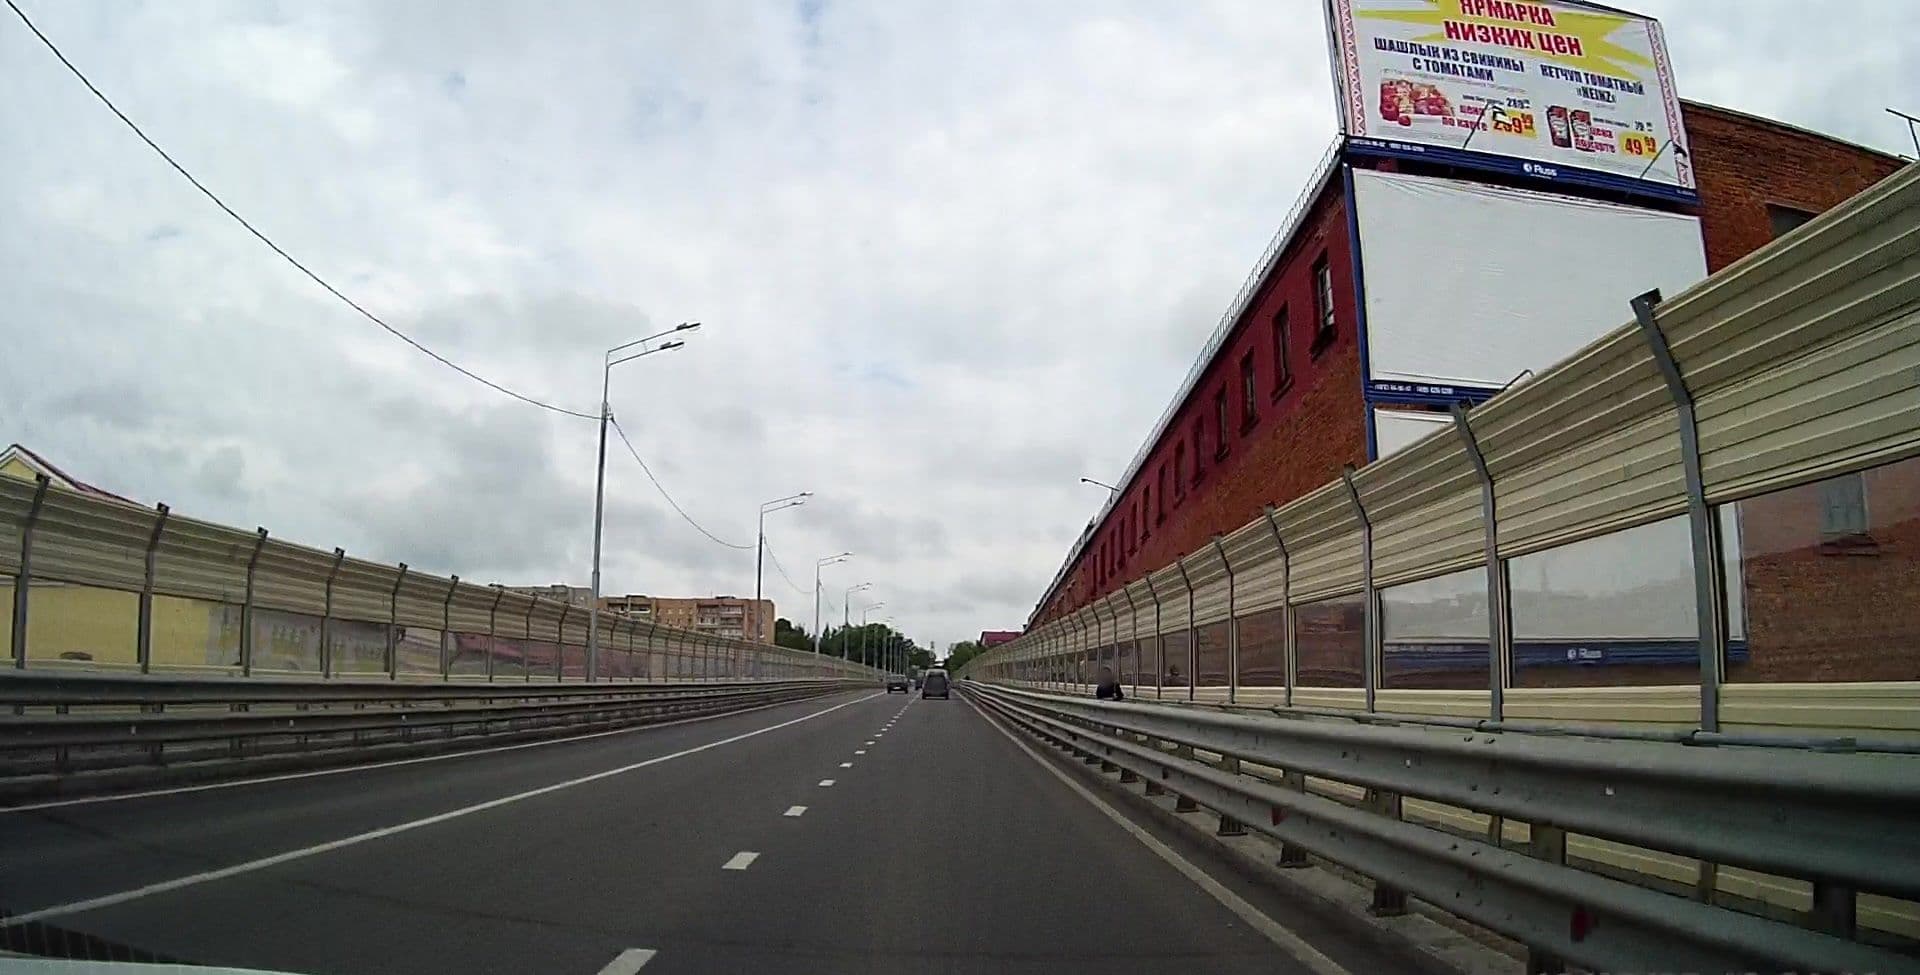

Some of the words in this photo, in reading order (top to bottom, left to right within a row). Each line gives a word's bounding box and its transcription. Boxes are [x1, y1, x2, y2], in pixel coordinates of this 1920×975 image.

[1460, 0, 1556, 26] ЯРМАРКА
[1443, 20, 1535, 49] НИЗКИХ
[1374, 37, 1441, 59] ШАШЛЫК
[1442, 47, 1459, 62] ИЗ
[1462, 50, 1525, 73] СВИНИНЫ
[1413, 57, 1422, 70] С
[1423, 59, 1494, 82] ТОМАТАМИ
[1540, 64, 1583, 83] КЕТЧУП
[1583, 72, 1644, 95] ТОМАТНЫЙ
[1625, 137, 1643, 156] 49
